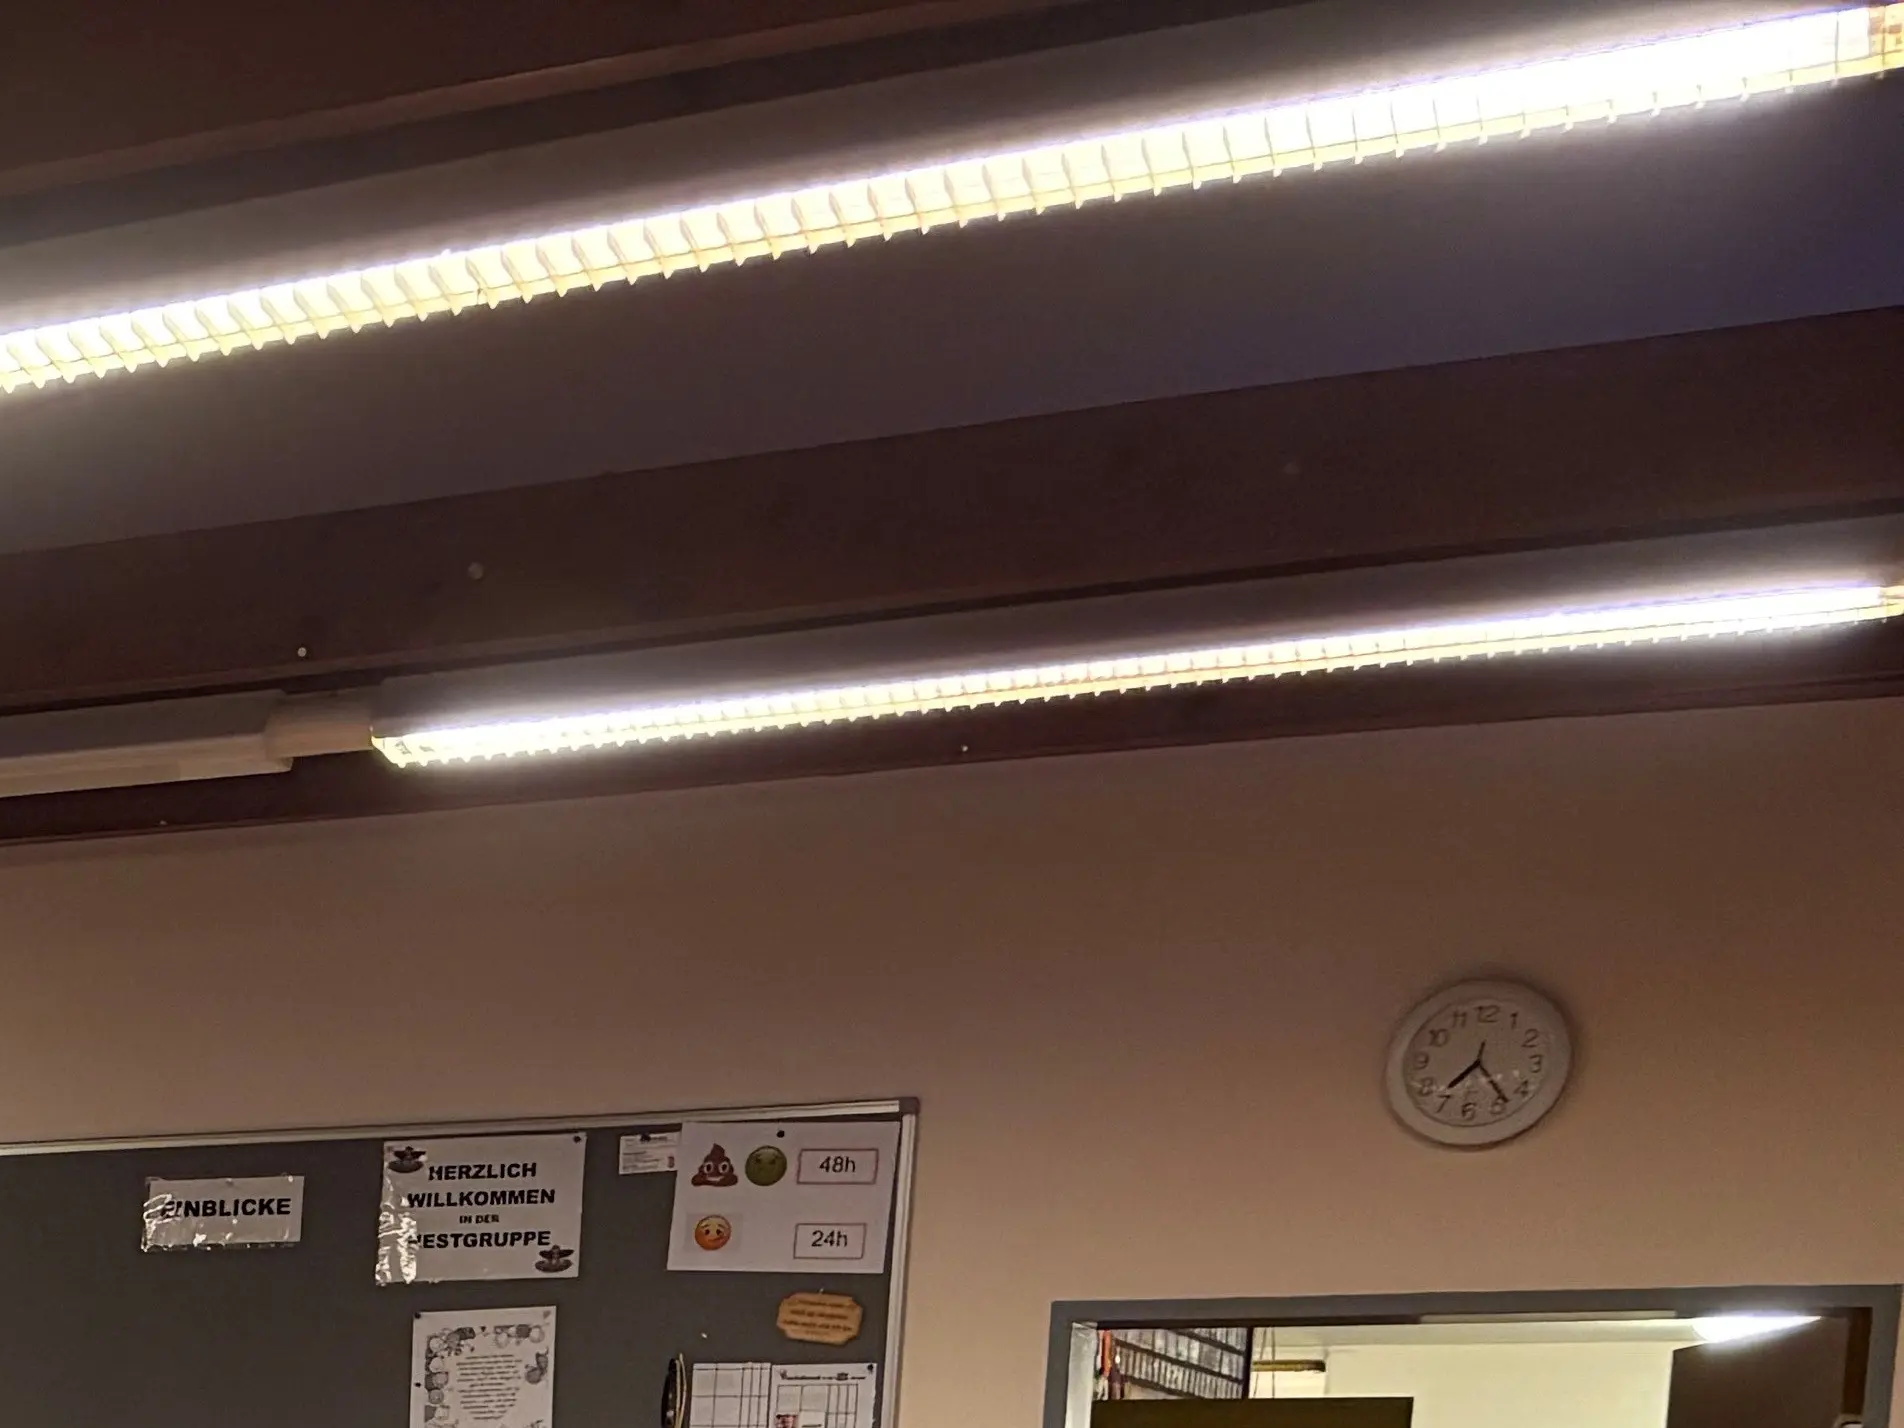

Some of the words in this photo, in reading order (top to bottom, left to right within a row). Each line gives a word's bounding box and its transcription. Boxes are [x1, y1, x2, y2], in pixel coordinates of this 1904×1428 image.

[1475, 1005, 1500, 1023] 12
[1510, 1012, 1519, 1029] 1
[1522, 1028, 1539, 1048] 2
[1414, 1053, 1429, 1070] 9
[1528, 1054, 1542, 1073] 3
[1418, 1077, 1434, 1096] 8
[1514, 1080, 1529, 1097] 4
[1436, 1094, 1451, 1113] 7
[428, 1162, 537, 1181] HERZLICH
[819, 1155, 856, 1174] 48h
[406, 1188, 556, 1208] WILLKOMMEN
[459, 1215, 472, 1224] IN
[475, 1214, 500, 1224] DER
[811, 1230, 848, 1248] 24h
